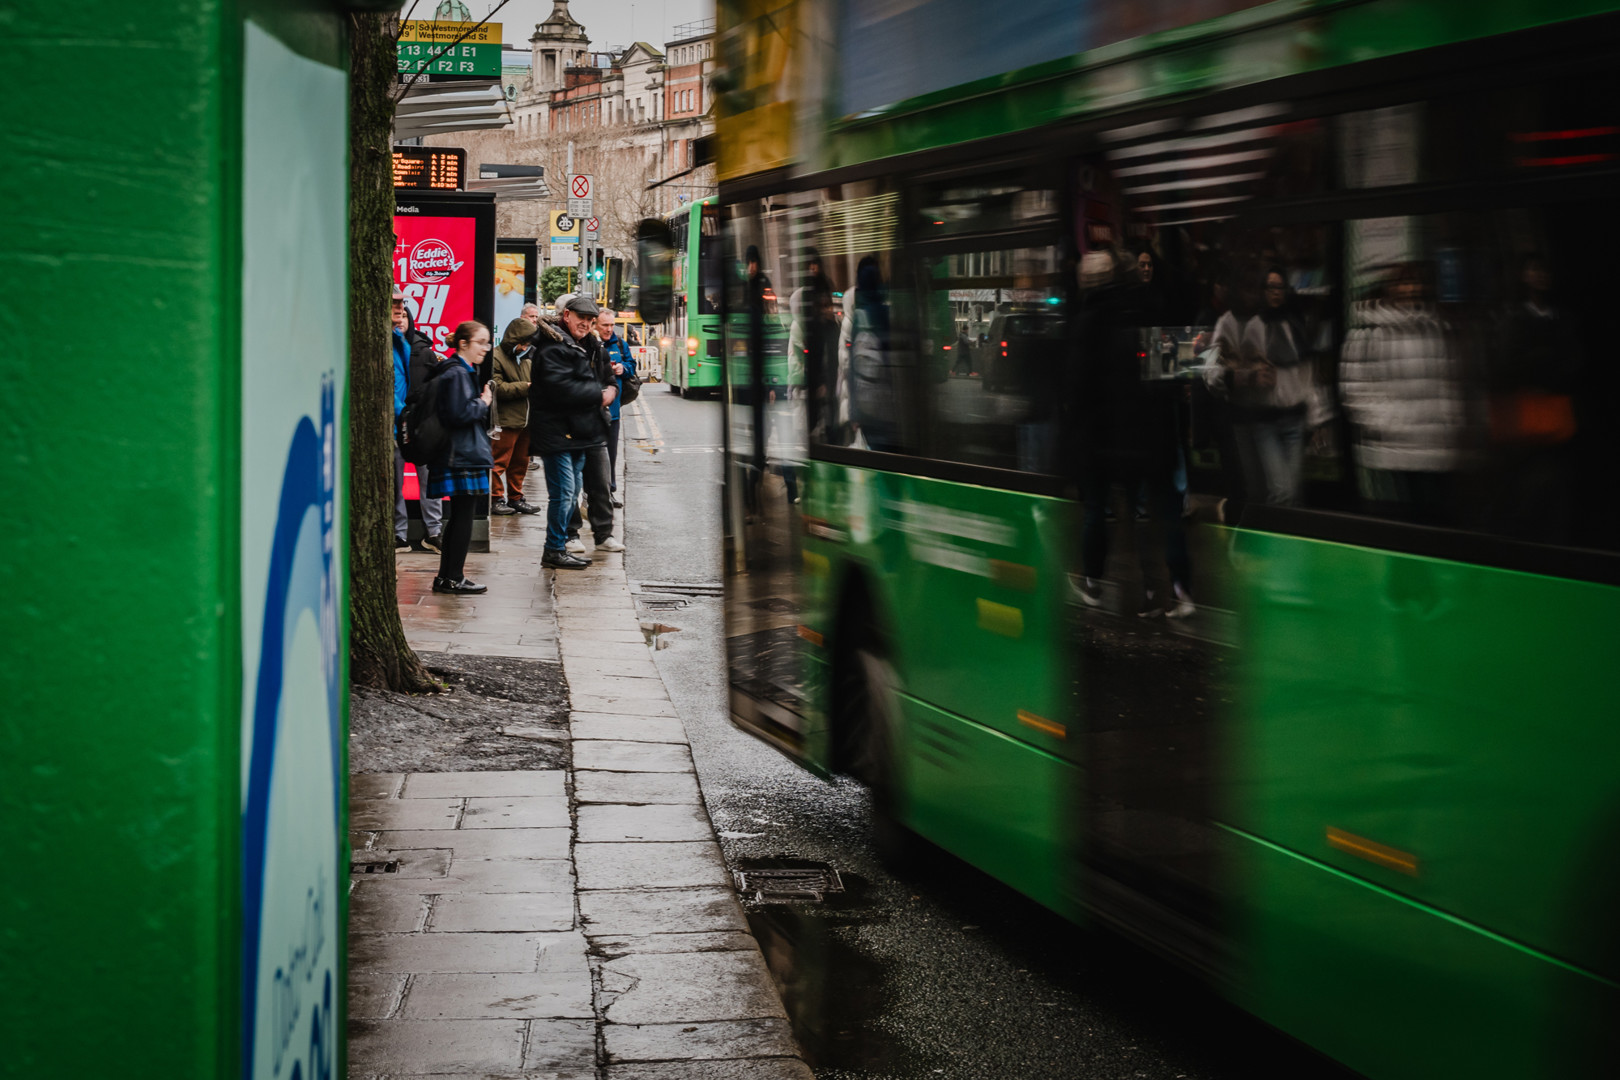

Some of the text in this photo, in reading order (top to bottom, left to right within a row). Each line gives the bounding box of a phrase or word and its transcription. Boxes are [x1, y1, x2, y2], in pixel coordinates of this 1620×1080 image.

[398, 24, 415, 32] Sop
[431, 24, 488, 33] Westmoreland
[478, 33, 488, 41] St
[407, 46, 420, 55] 13
[463, 46, 476, 57] E1
[439, 61, 453, 71] F2
[460, 61, 474, 72] F3
[416, 247, 448, 260] Eddie
[410, 256, 455, 270] Rocket's
